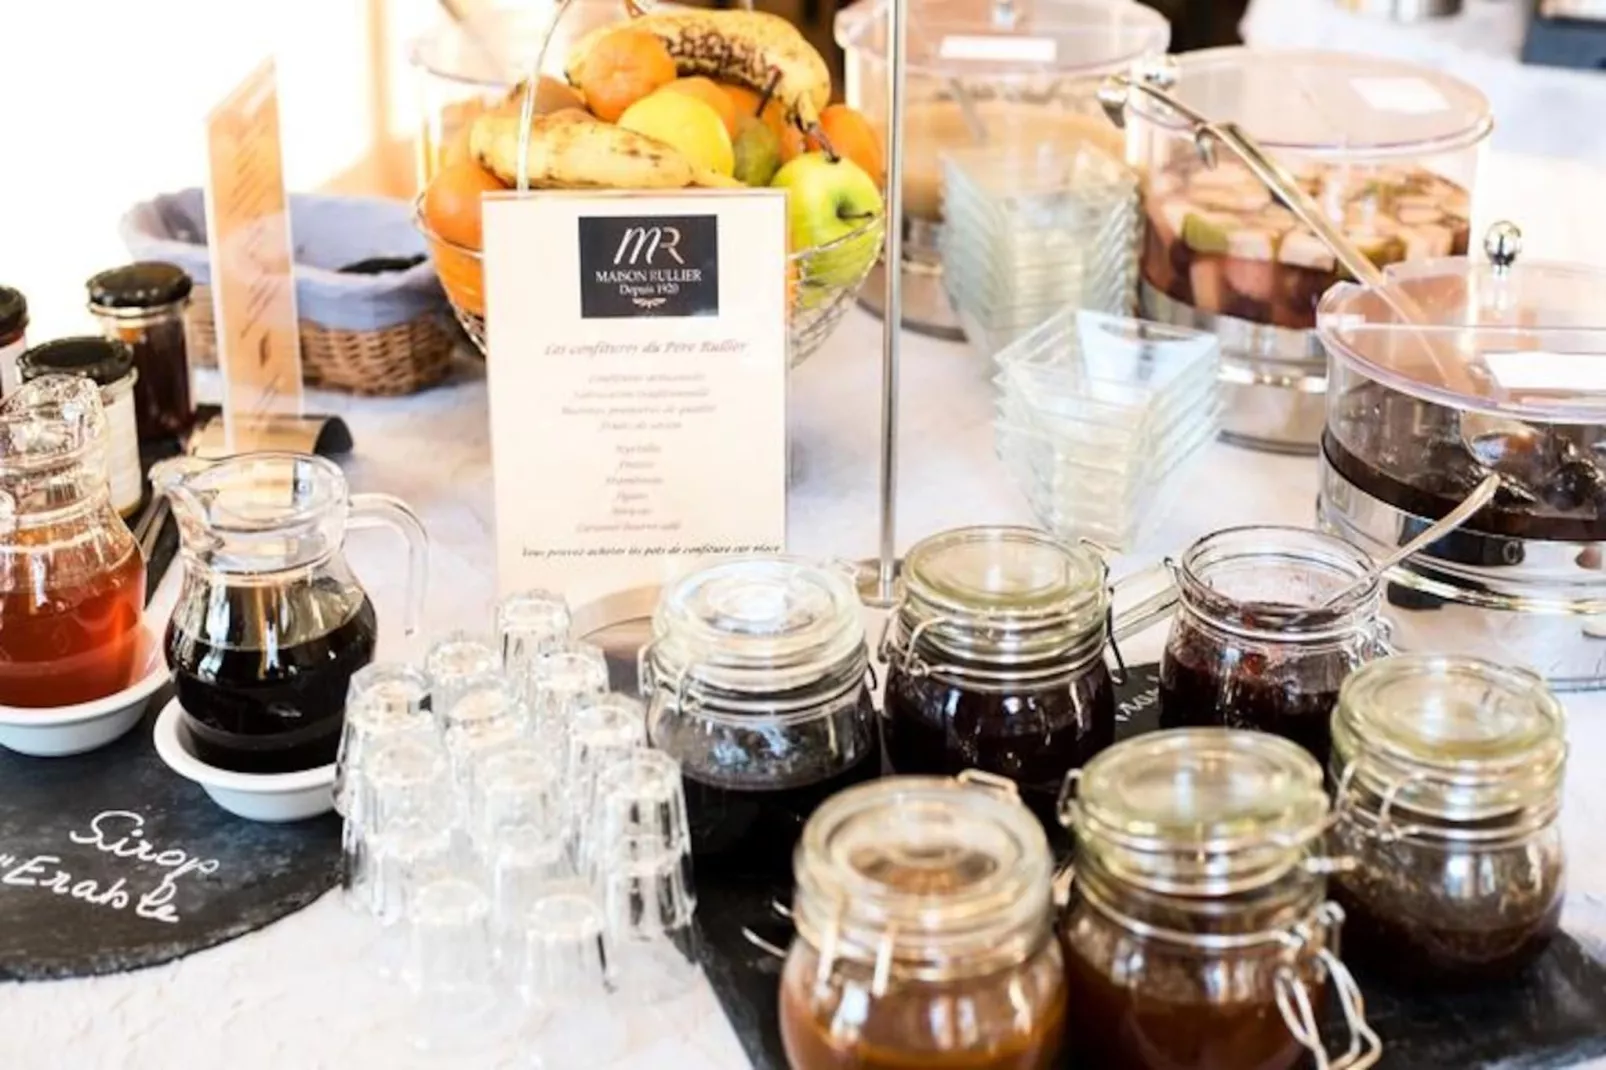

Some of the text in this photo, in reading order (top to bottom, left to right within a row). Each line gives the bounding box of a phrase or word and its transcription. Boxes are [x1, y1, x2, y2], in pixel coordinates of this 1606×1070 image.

[613, 226, 685, 265] MR
[595, 269, 702, 283] MAISON RULLIER
[619, 283, 655, 297] Depuis
[69, 810, 220, 884] Sirop
